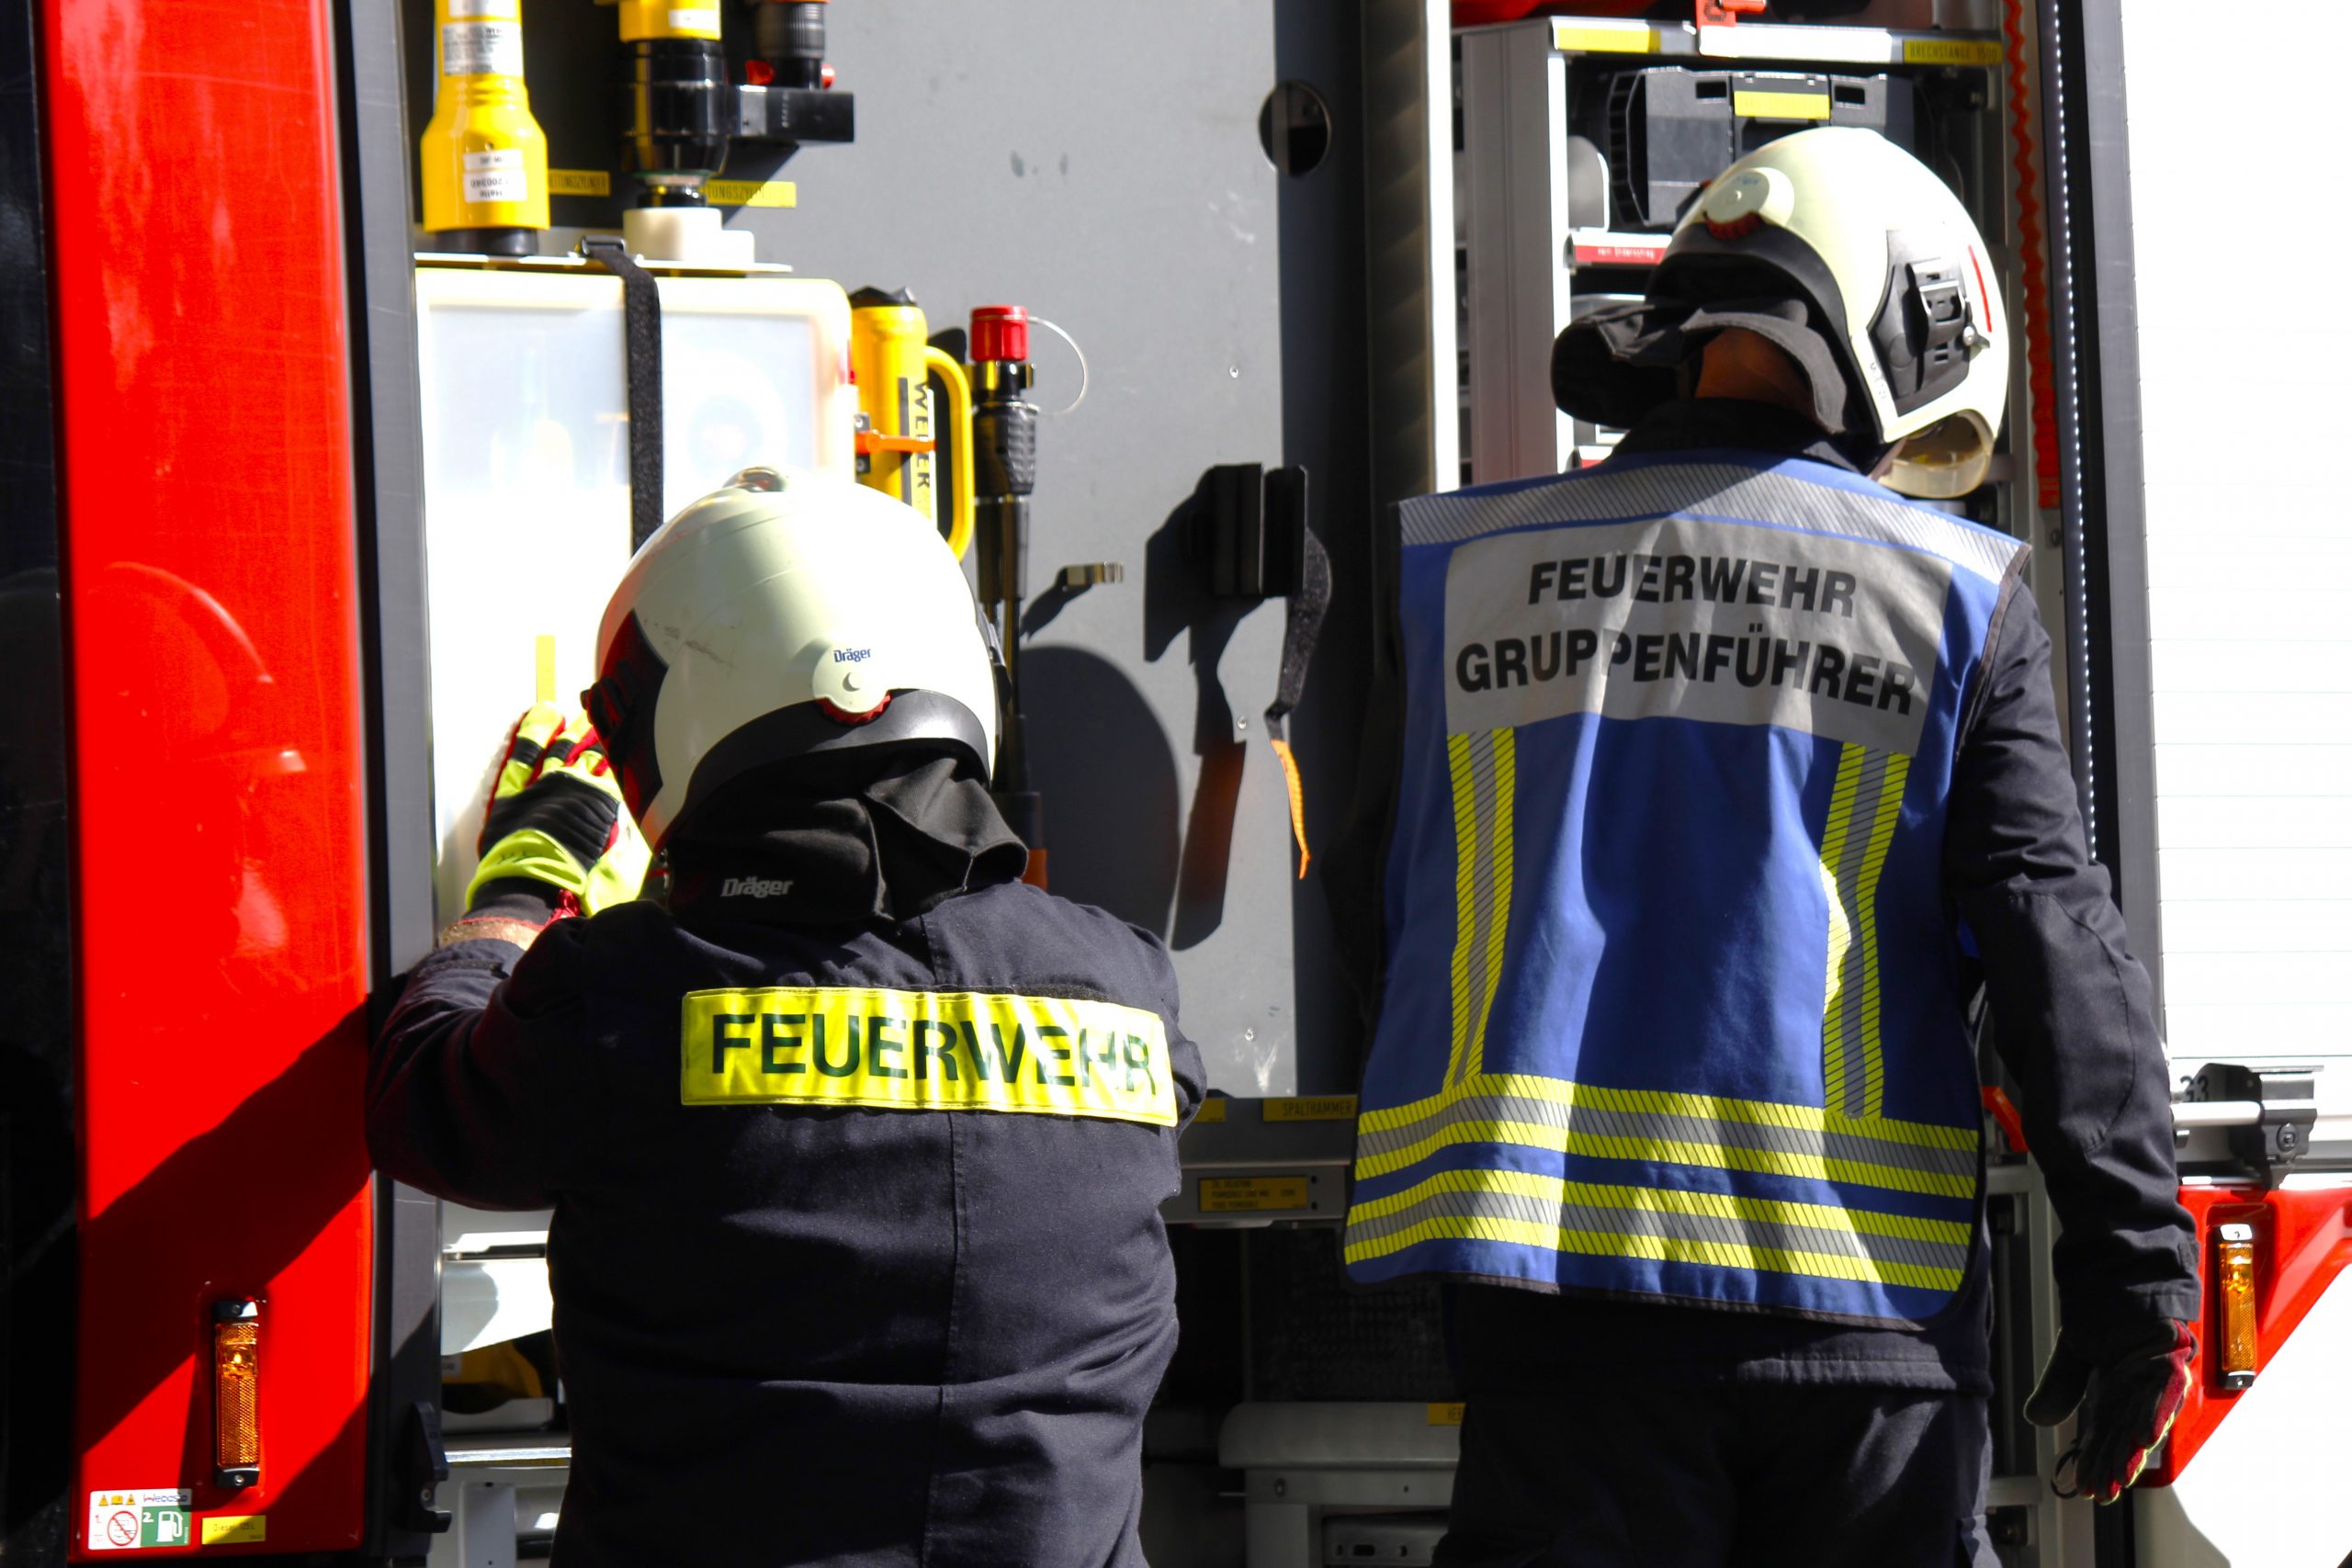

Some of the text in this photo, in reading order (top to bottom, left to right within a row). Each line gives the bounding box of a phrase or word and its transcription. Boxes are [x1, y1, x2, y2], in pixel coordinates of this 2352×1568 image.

[1910, 43, 1970, 60] BRECHSTANGE
[914, 381, 931, 489] WEER
[1527, 554, 1857, 618] FEUERWEHR
[833, 649, 871, 662] Dräger
[1455, 623, 1915, 716] GRUPPENFÜHRER
[720, 876, 793, 898] Dräger
[712, 1013, 1157, 1096] FEUERWEHR
[1282, 1101, 1351, 1117] SPALTHAMMER
